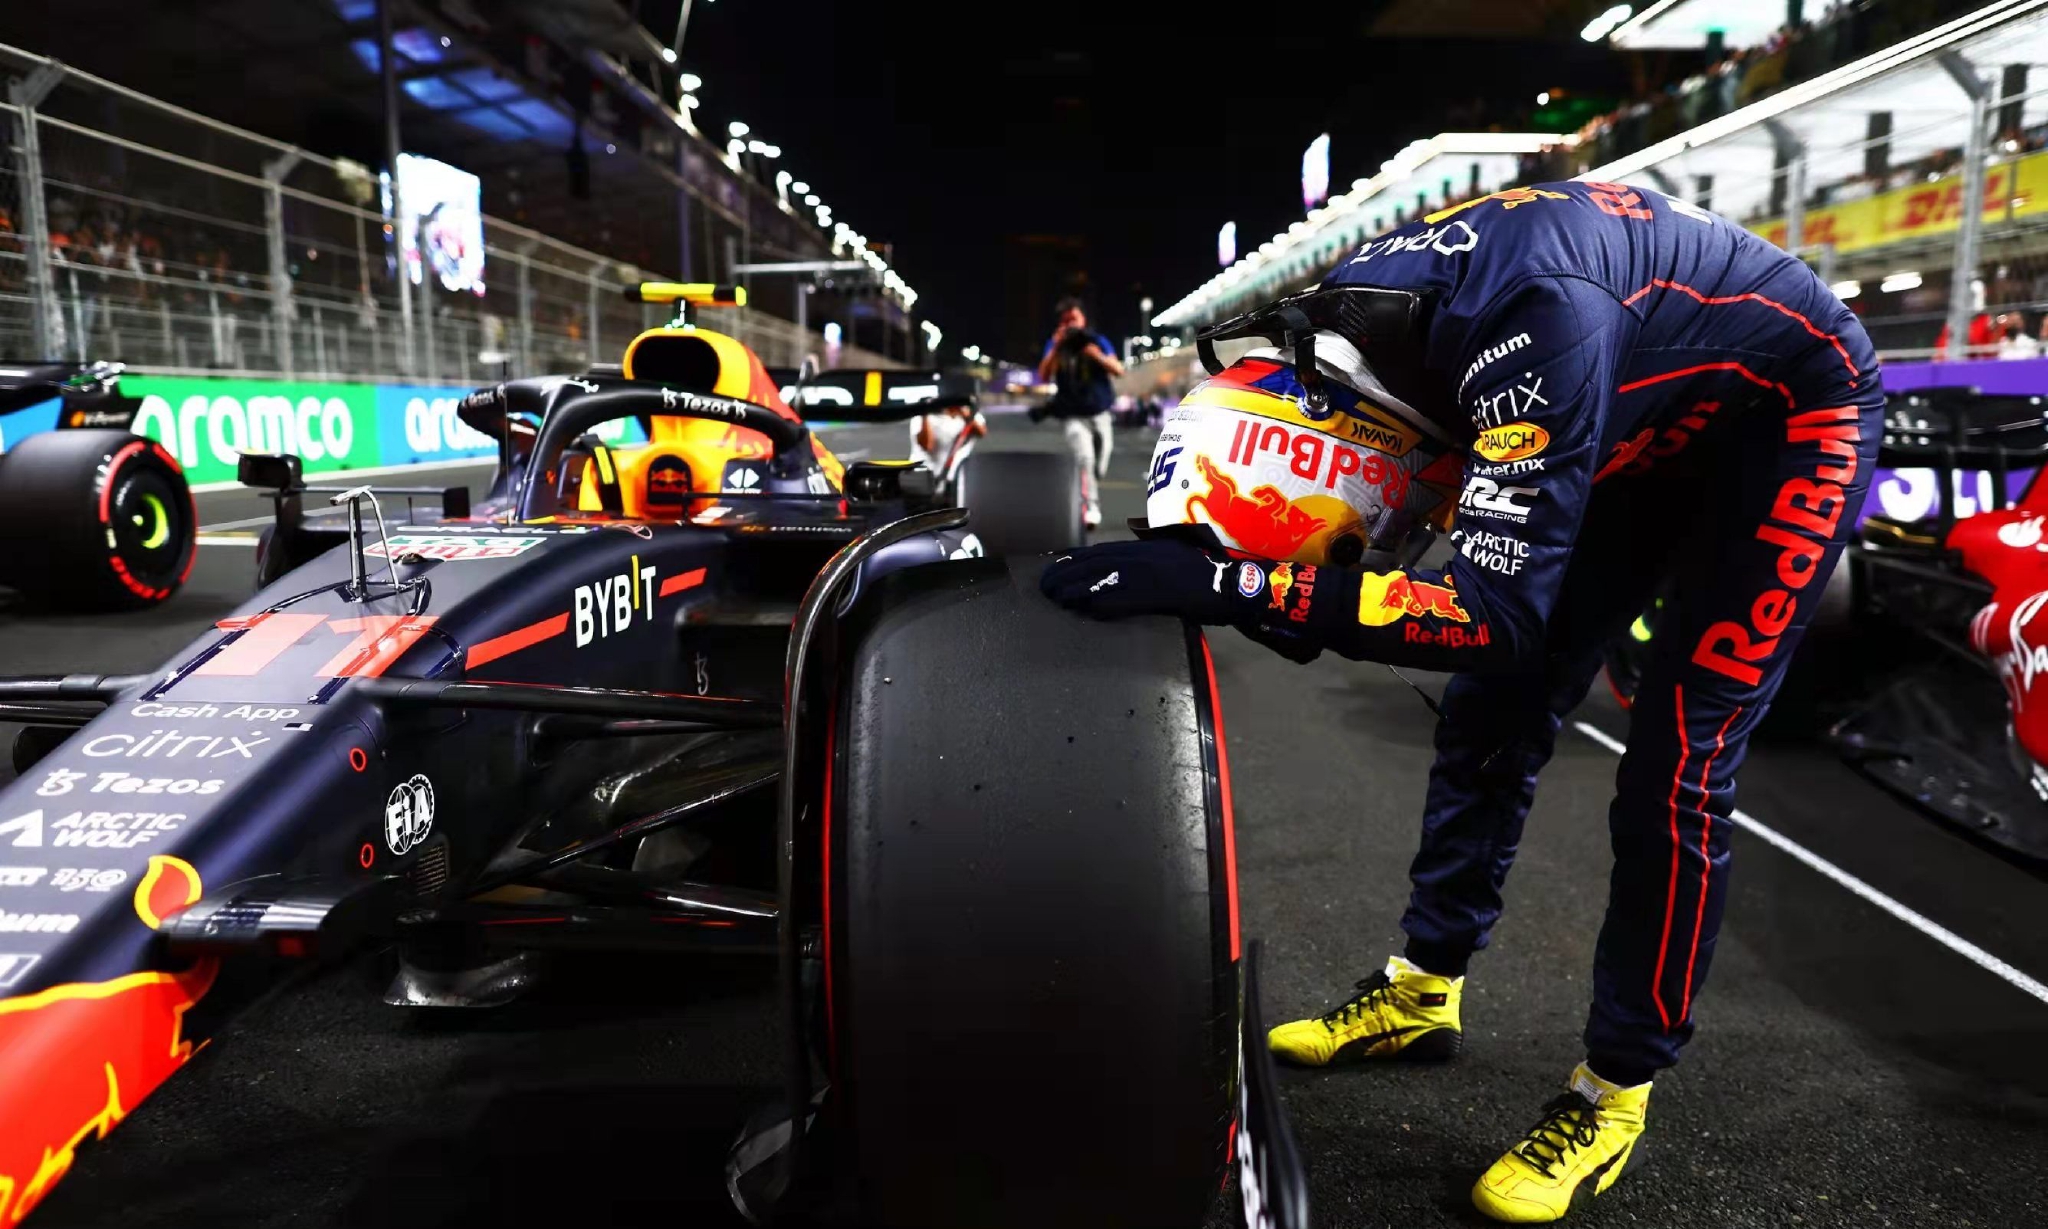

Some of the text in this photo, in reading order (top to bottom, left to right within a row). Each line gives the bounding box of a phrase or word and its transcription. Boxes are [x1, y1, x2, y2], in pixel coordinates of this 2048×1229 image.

[680, 392, 730, 415] Tezos
[129, 394, 353, 467] aramco
[405, 397, 499, 452] ara
[1481, 431, 1535, 450] RAUCH
[1476, 509, 1528, 524] RACING
[1472, 531, 1530, 558] ARCTIC
[1692, 405, 1862, 686] Red Bull
[1474, 547, 1524, 576] WOLF
[1243, 566, 1256, 591] Esso
[574, 554, 657, 648] BYBIT
[191, 613, 441, 678] 11
[131, 703, 300, 723] Cash App
[90, 772, 226, 795] Tezos
[51, 811, 187, 831] ARCTIC
[51, 831, 162, 849] WOLF
